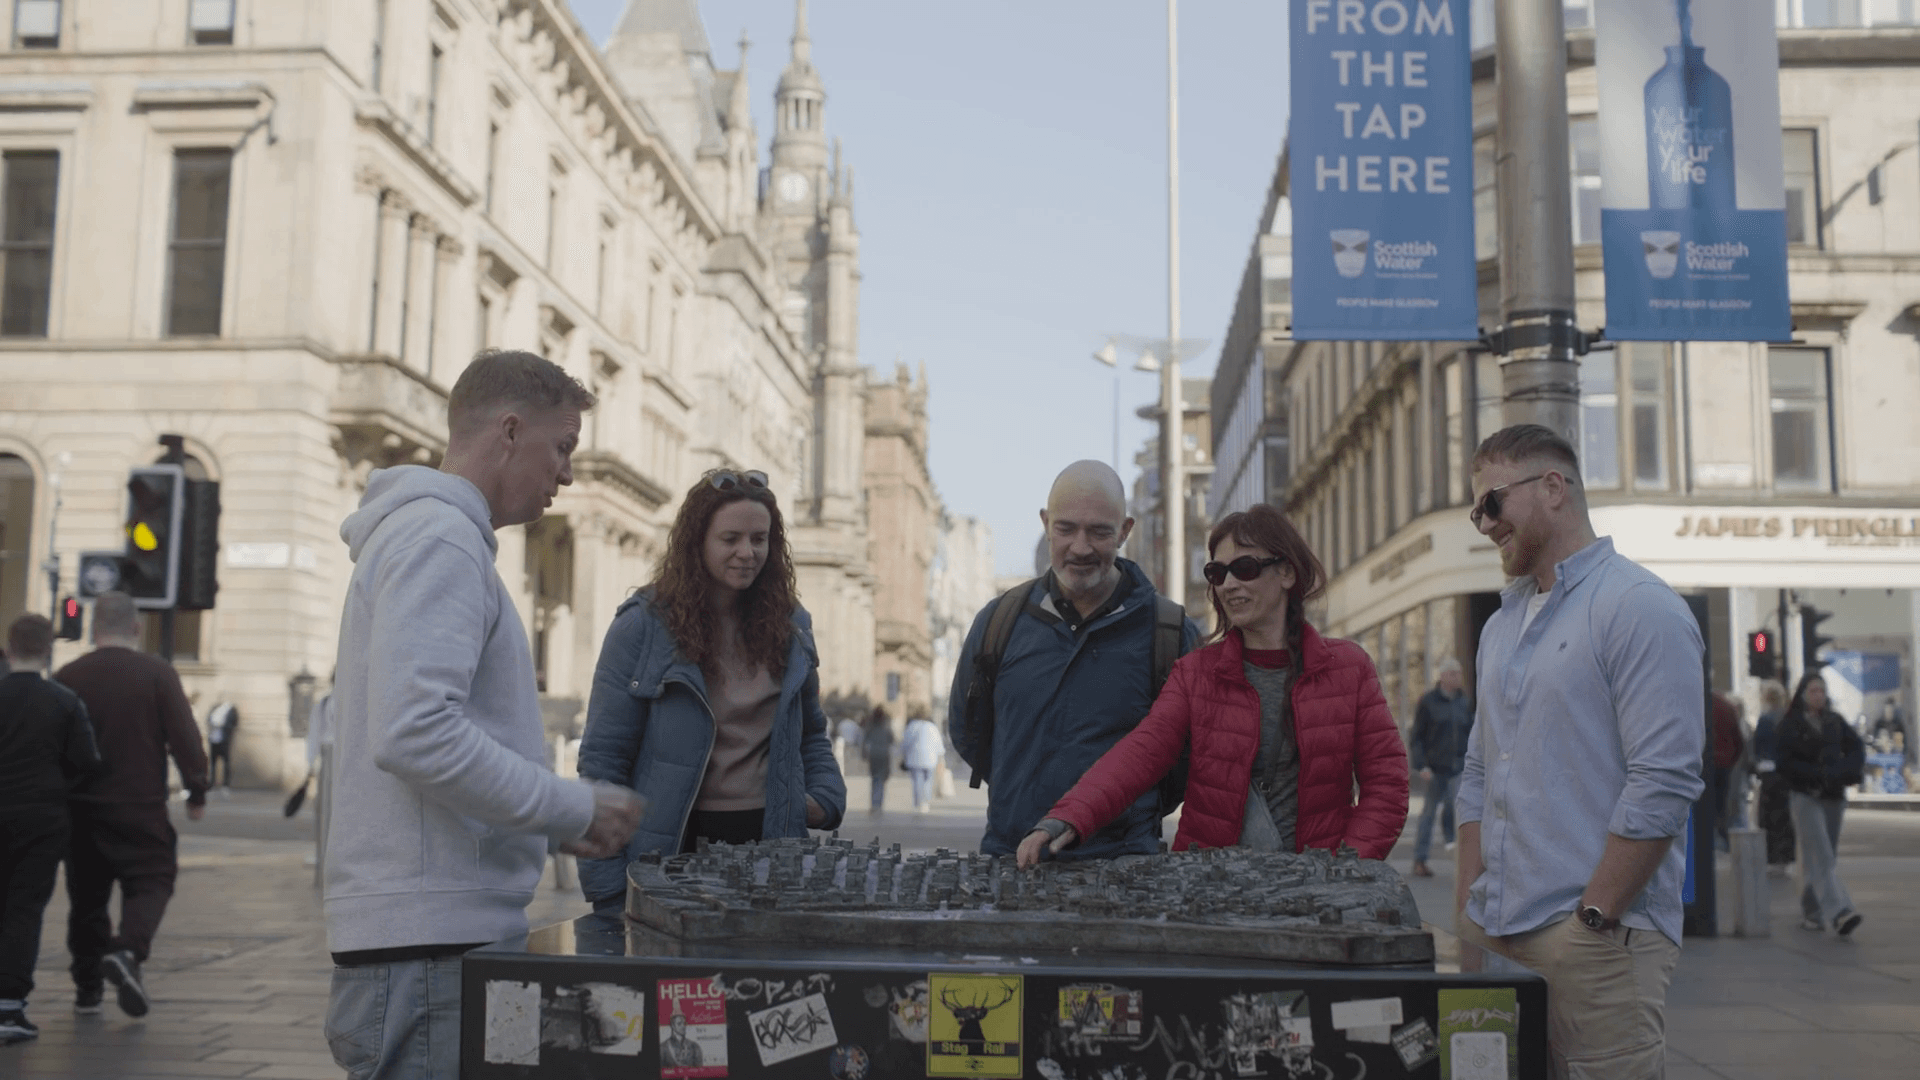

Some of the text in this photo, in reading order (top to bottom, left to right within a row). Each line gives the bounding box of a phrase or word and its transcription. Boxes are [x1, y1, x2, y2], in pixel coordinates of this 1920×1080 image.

[1306, 0, 1455, 36] FROM
[1331, 50, 1428, 88] THE
[1334, 102, 1427, 140] TAP
[1315, 155, 1451, 194] HERE
[1374, 240, 1438, 257] Scottish
[1685, 240, 1750, 257] Scottish
[1374, 254, 1425, 271] Water
[1686, 255, 1736, 271] Water
[1675, 516, 1782, 538] JAMES
[660, 983, 722, 1000] HELLO
[941, 1042, 969, 1055] Stag
